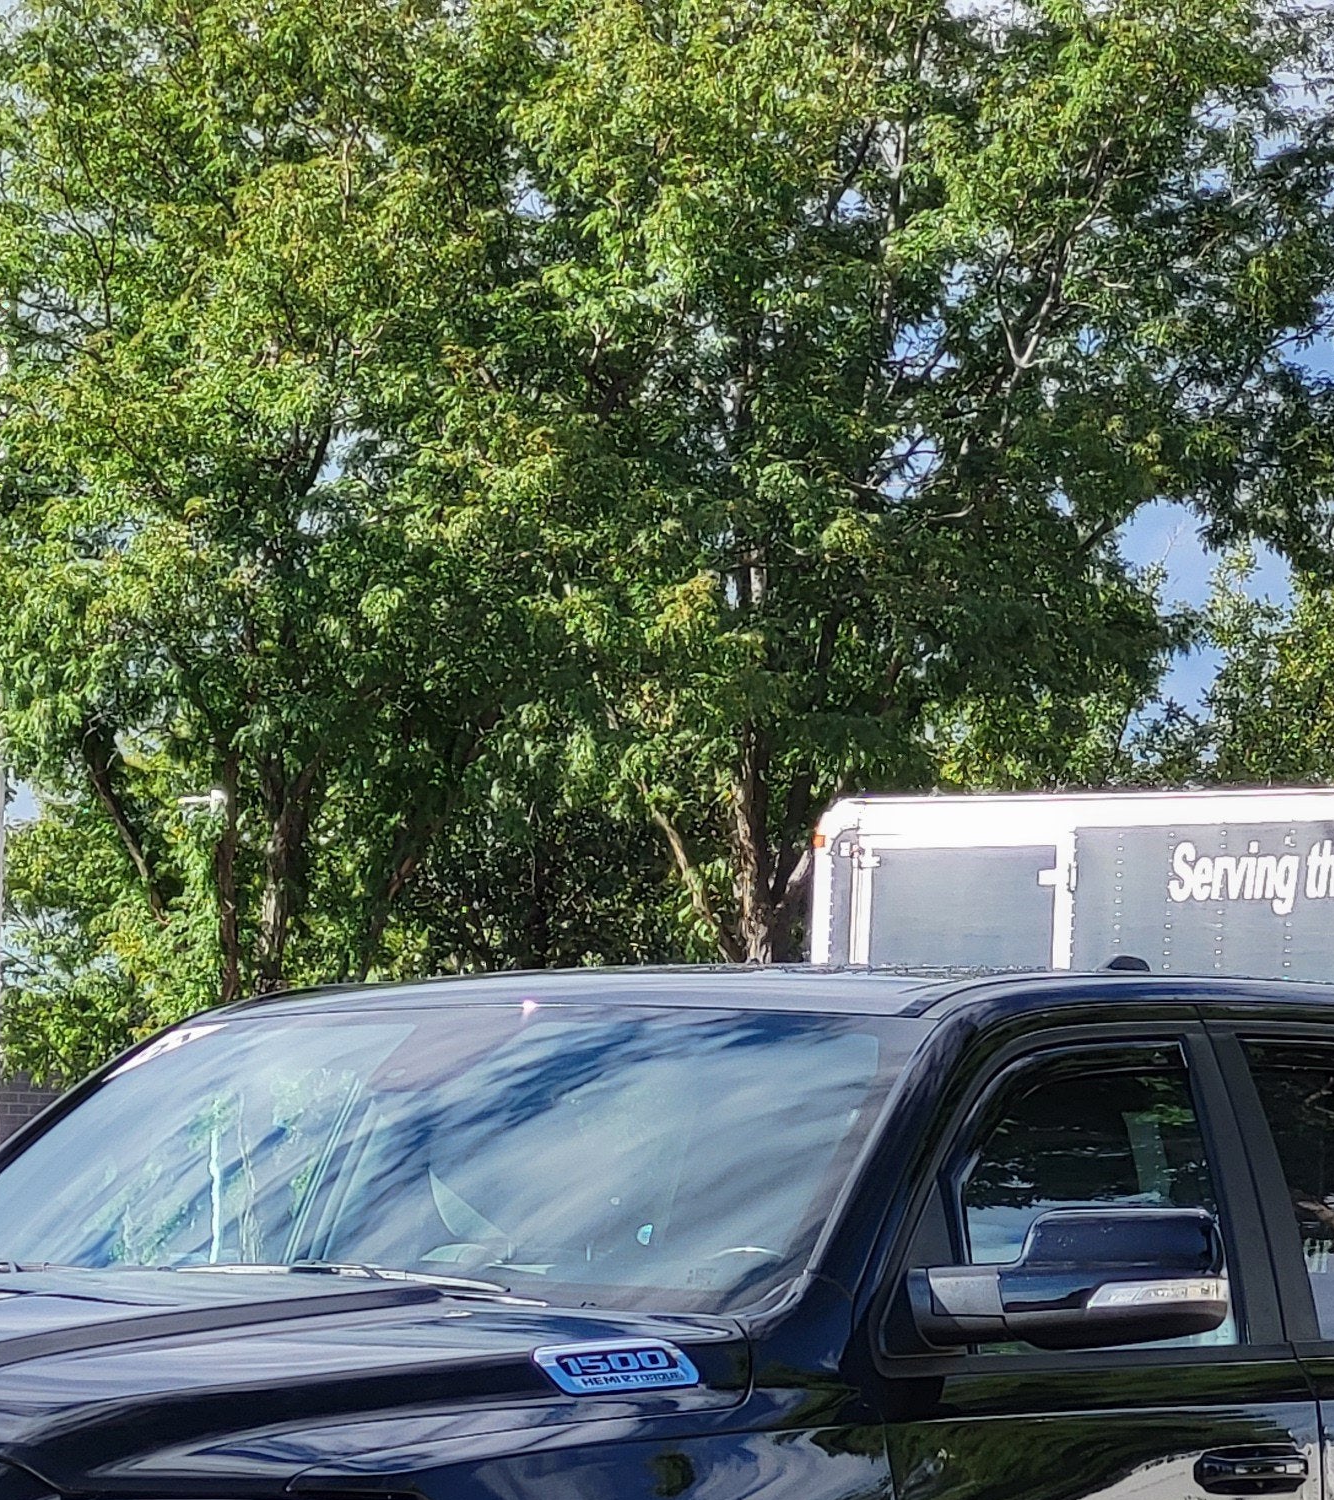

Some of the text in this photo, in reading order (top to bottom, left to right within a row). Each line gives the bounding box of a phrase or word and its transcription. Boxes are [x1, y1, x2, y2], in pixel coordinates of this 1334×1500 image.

[1168, 840, 1300, 915] Serving
[560, 1351, 668, 1375] 1500
[581, 1374, 621, 1387] HEMI
